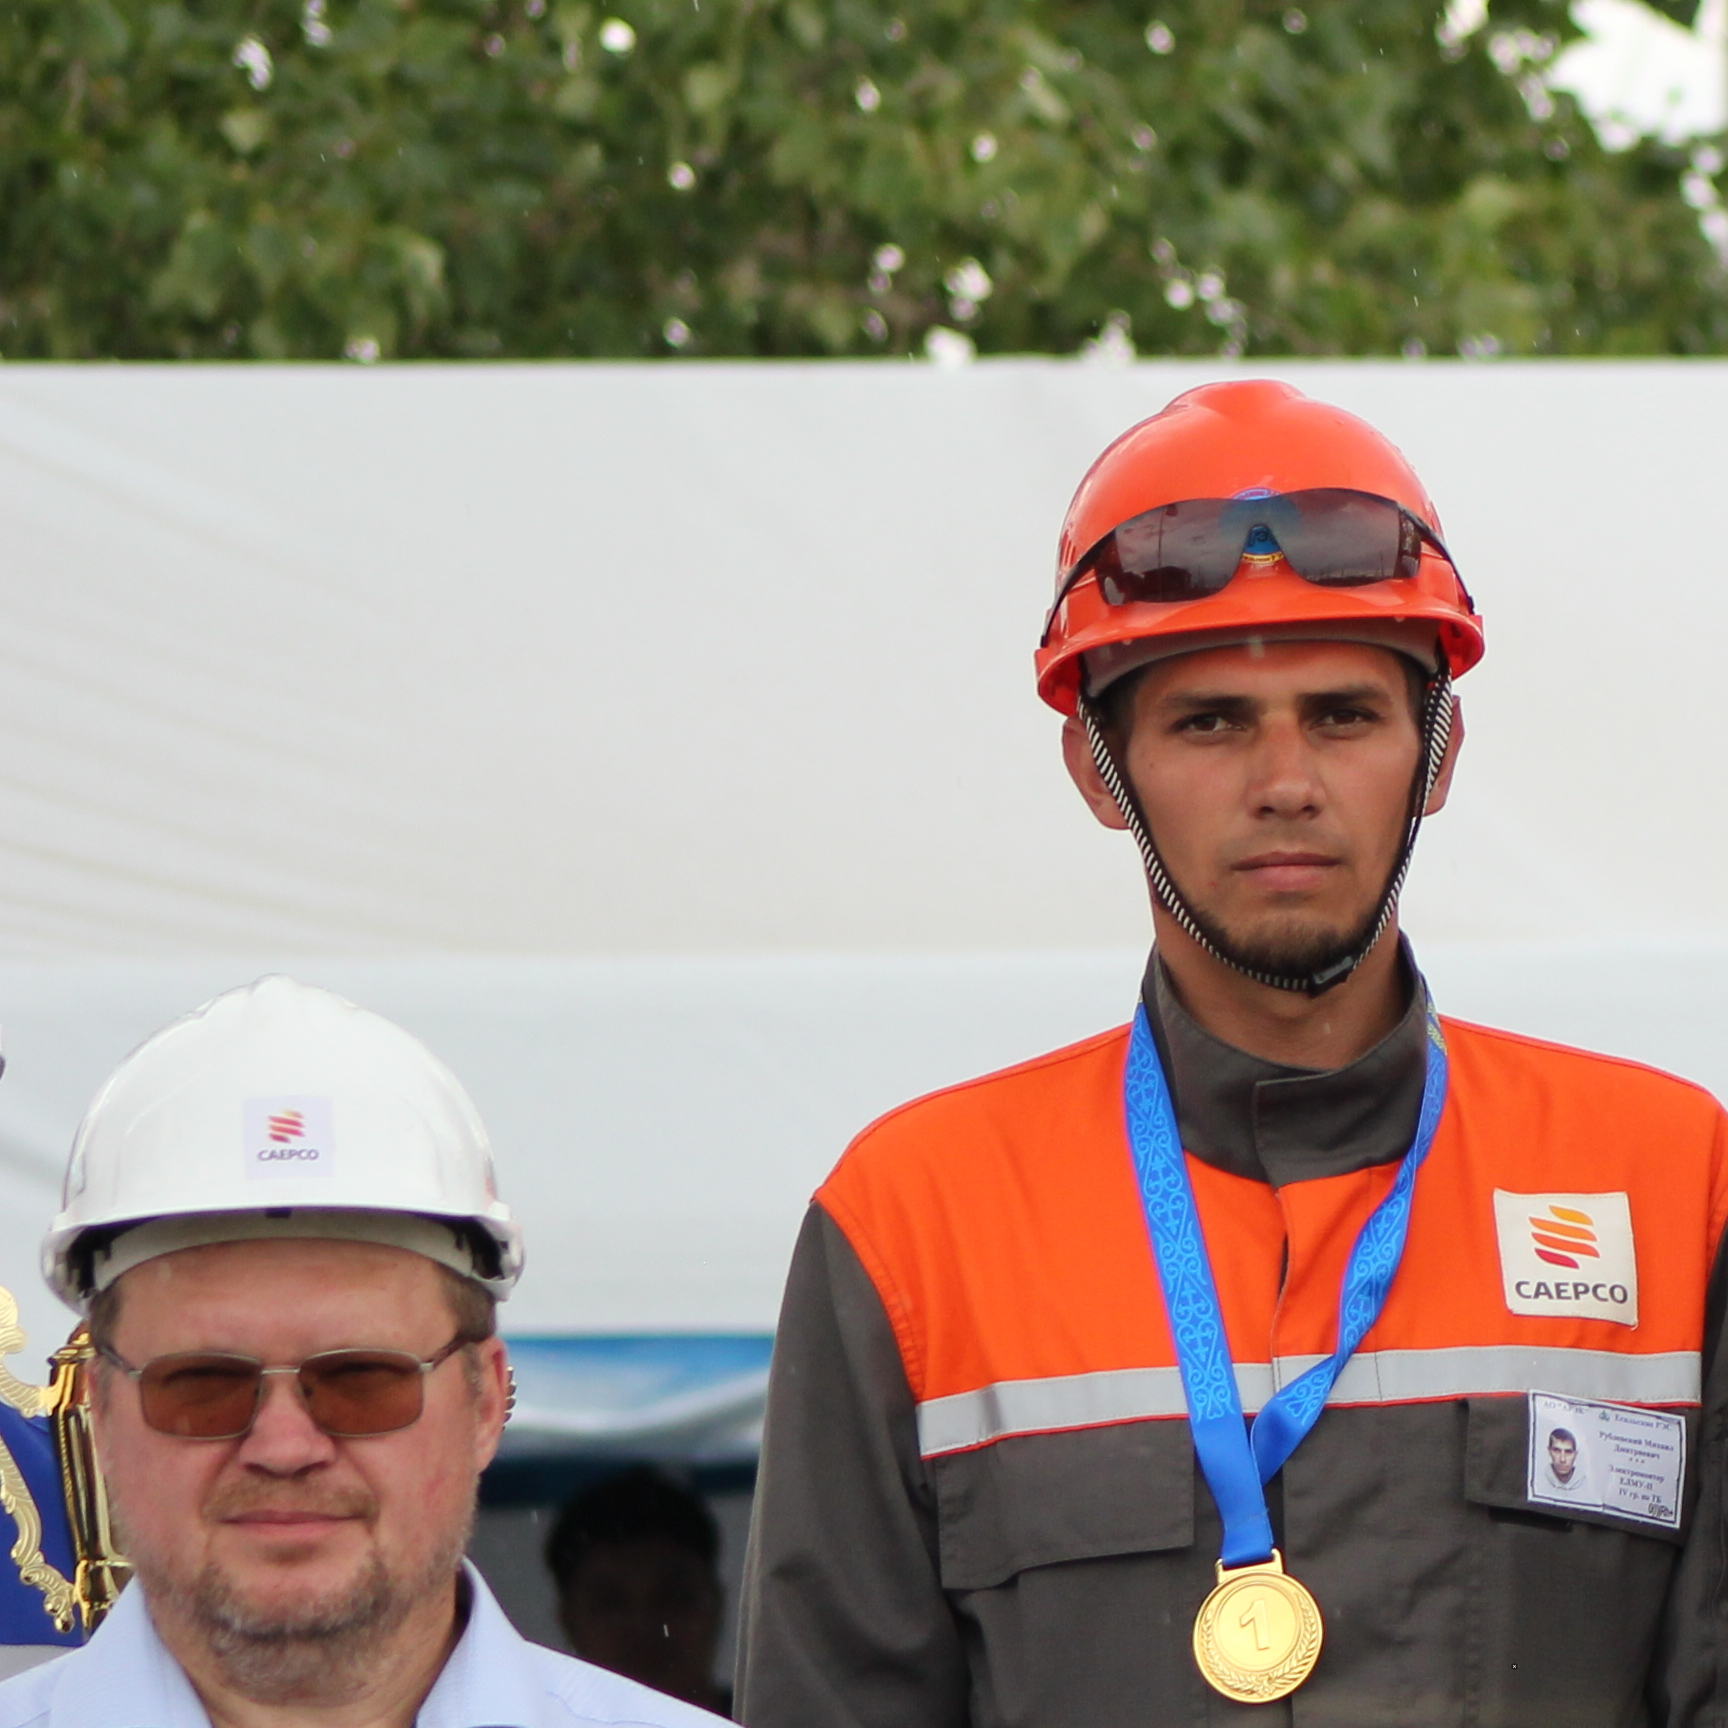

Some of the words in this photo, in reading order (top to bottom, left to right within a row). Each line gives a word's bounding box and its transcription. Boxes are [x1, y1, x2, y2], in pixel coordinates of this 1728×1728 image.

[257, 1149, 320, 1161] CAEPCO
[1514, 1281, 1629, 1305] CAEPCO
[1239, 1598, 1271, 1651] 1
